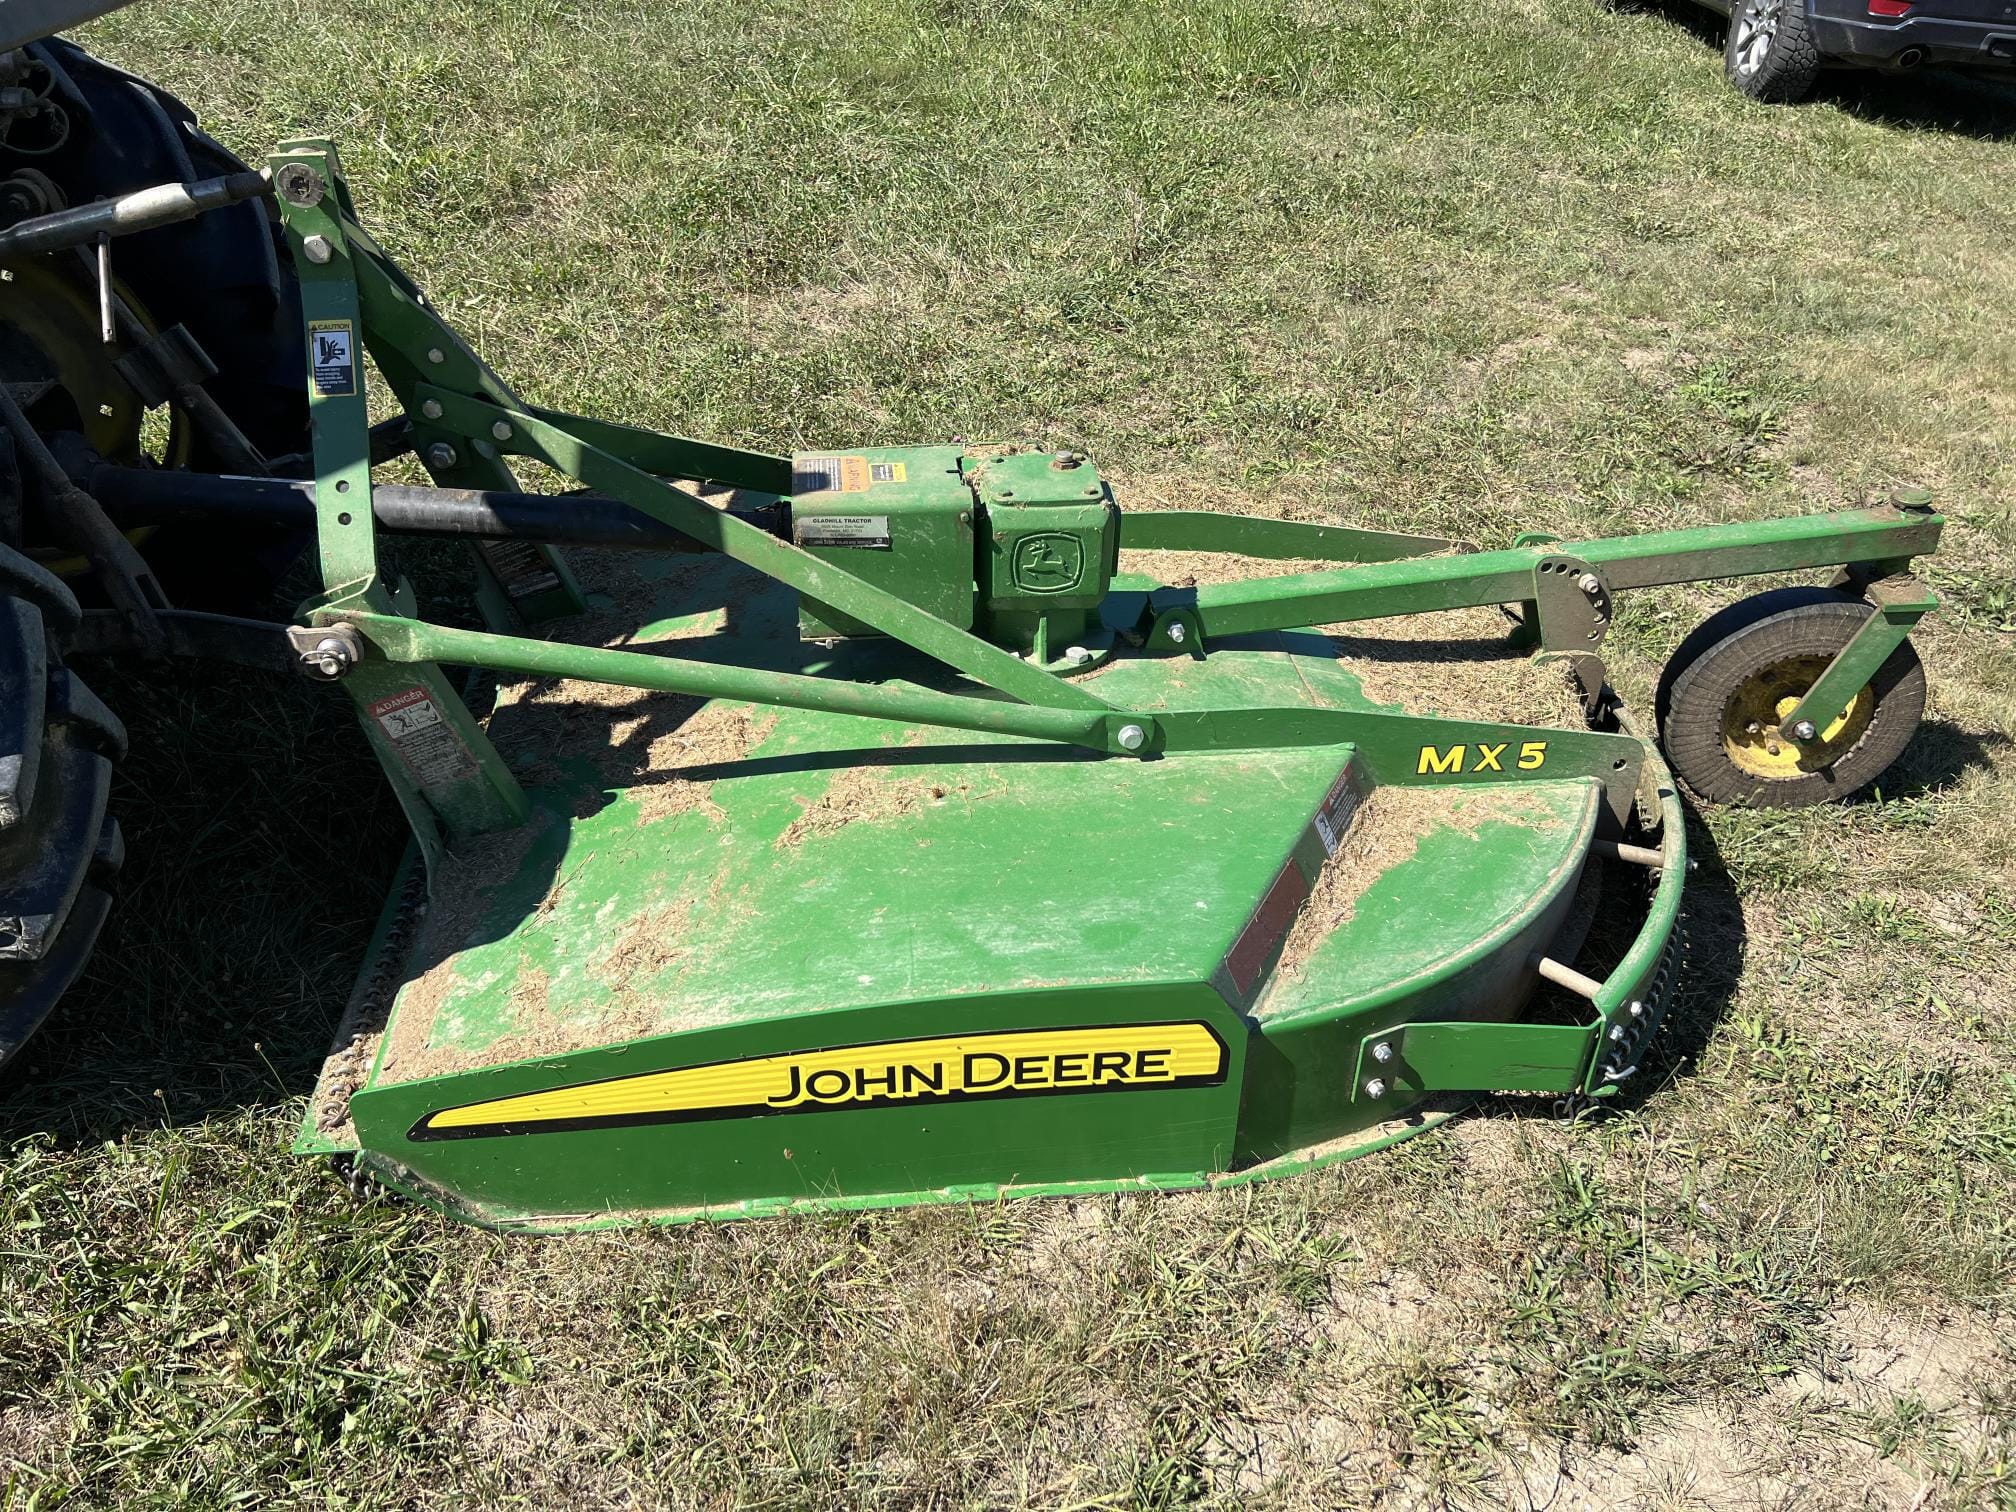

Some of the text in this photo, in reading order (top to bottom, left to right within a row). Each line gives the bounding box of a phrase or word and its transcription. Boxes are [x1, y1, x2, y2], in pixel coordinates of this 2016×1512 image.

[383, 690, 425, 710] DANGER
[767, 1048, 1172, 1103] JOHN DEERE
